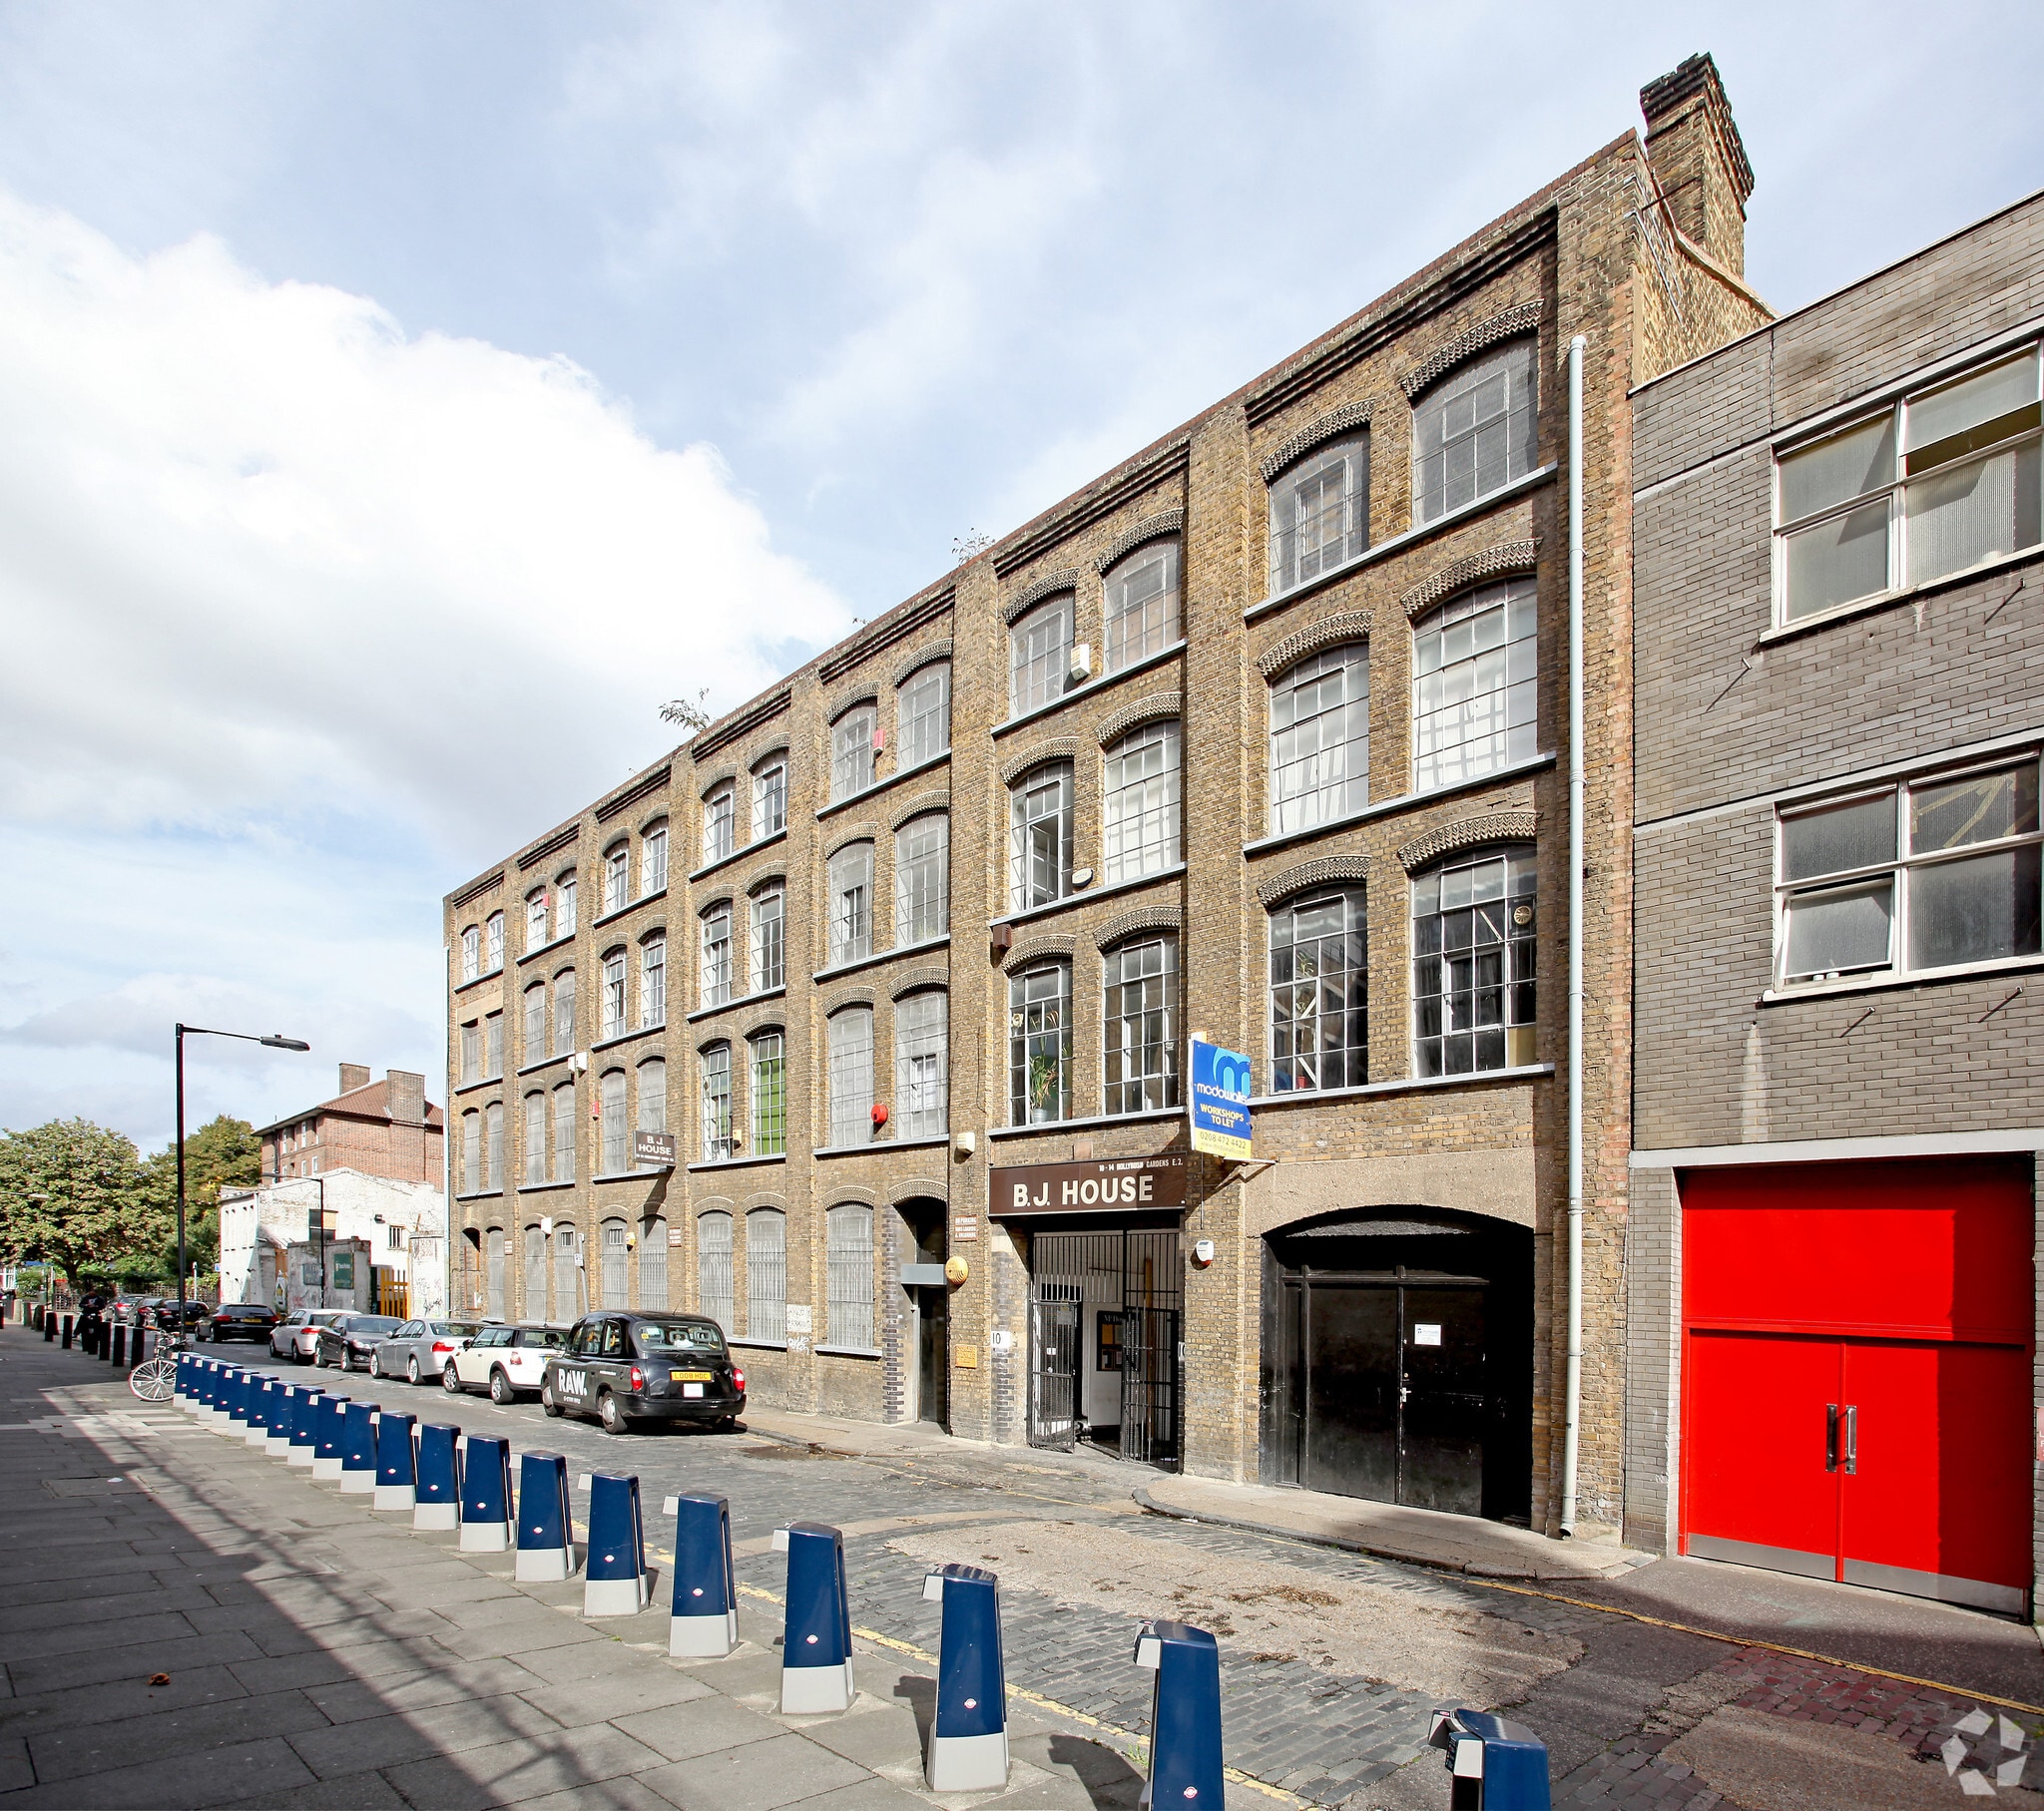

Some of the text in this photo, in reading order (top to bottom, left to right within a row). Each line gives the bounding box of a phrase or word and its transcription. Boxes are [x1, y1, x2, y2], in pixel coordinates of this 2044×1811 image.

[1197, 1083, 1248, 1105] mcdowalls
[1200, 1103, 1245, 1122] WORKSHOPS
[1212, 1115, 1235, 1128] TO LET
[1200, 1131, 1246, 1149] 0208 472 4422
[639, 1143, 672, 1155] HOUSE
[1146, 1159, 1169, 1168] GARDENS
[1061, 1174, 1153, 1205] HOUSE
[993, 1333, 1001, 1345] 10
